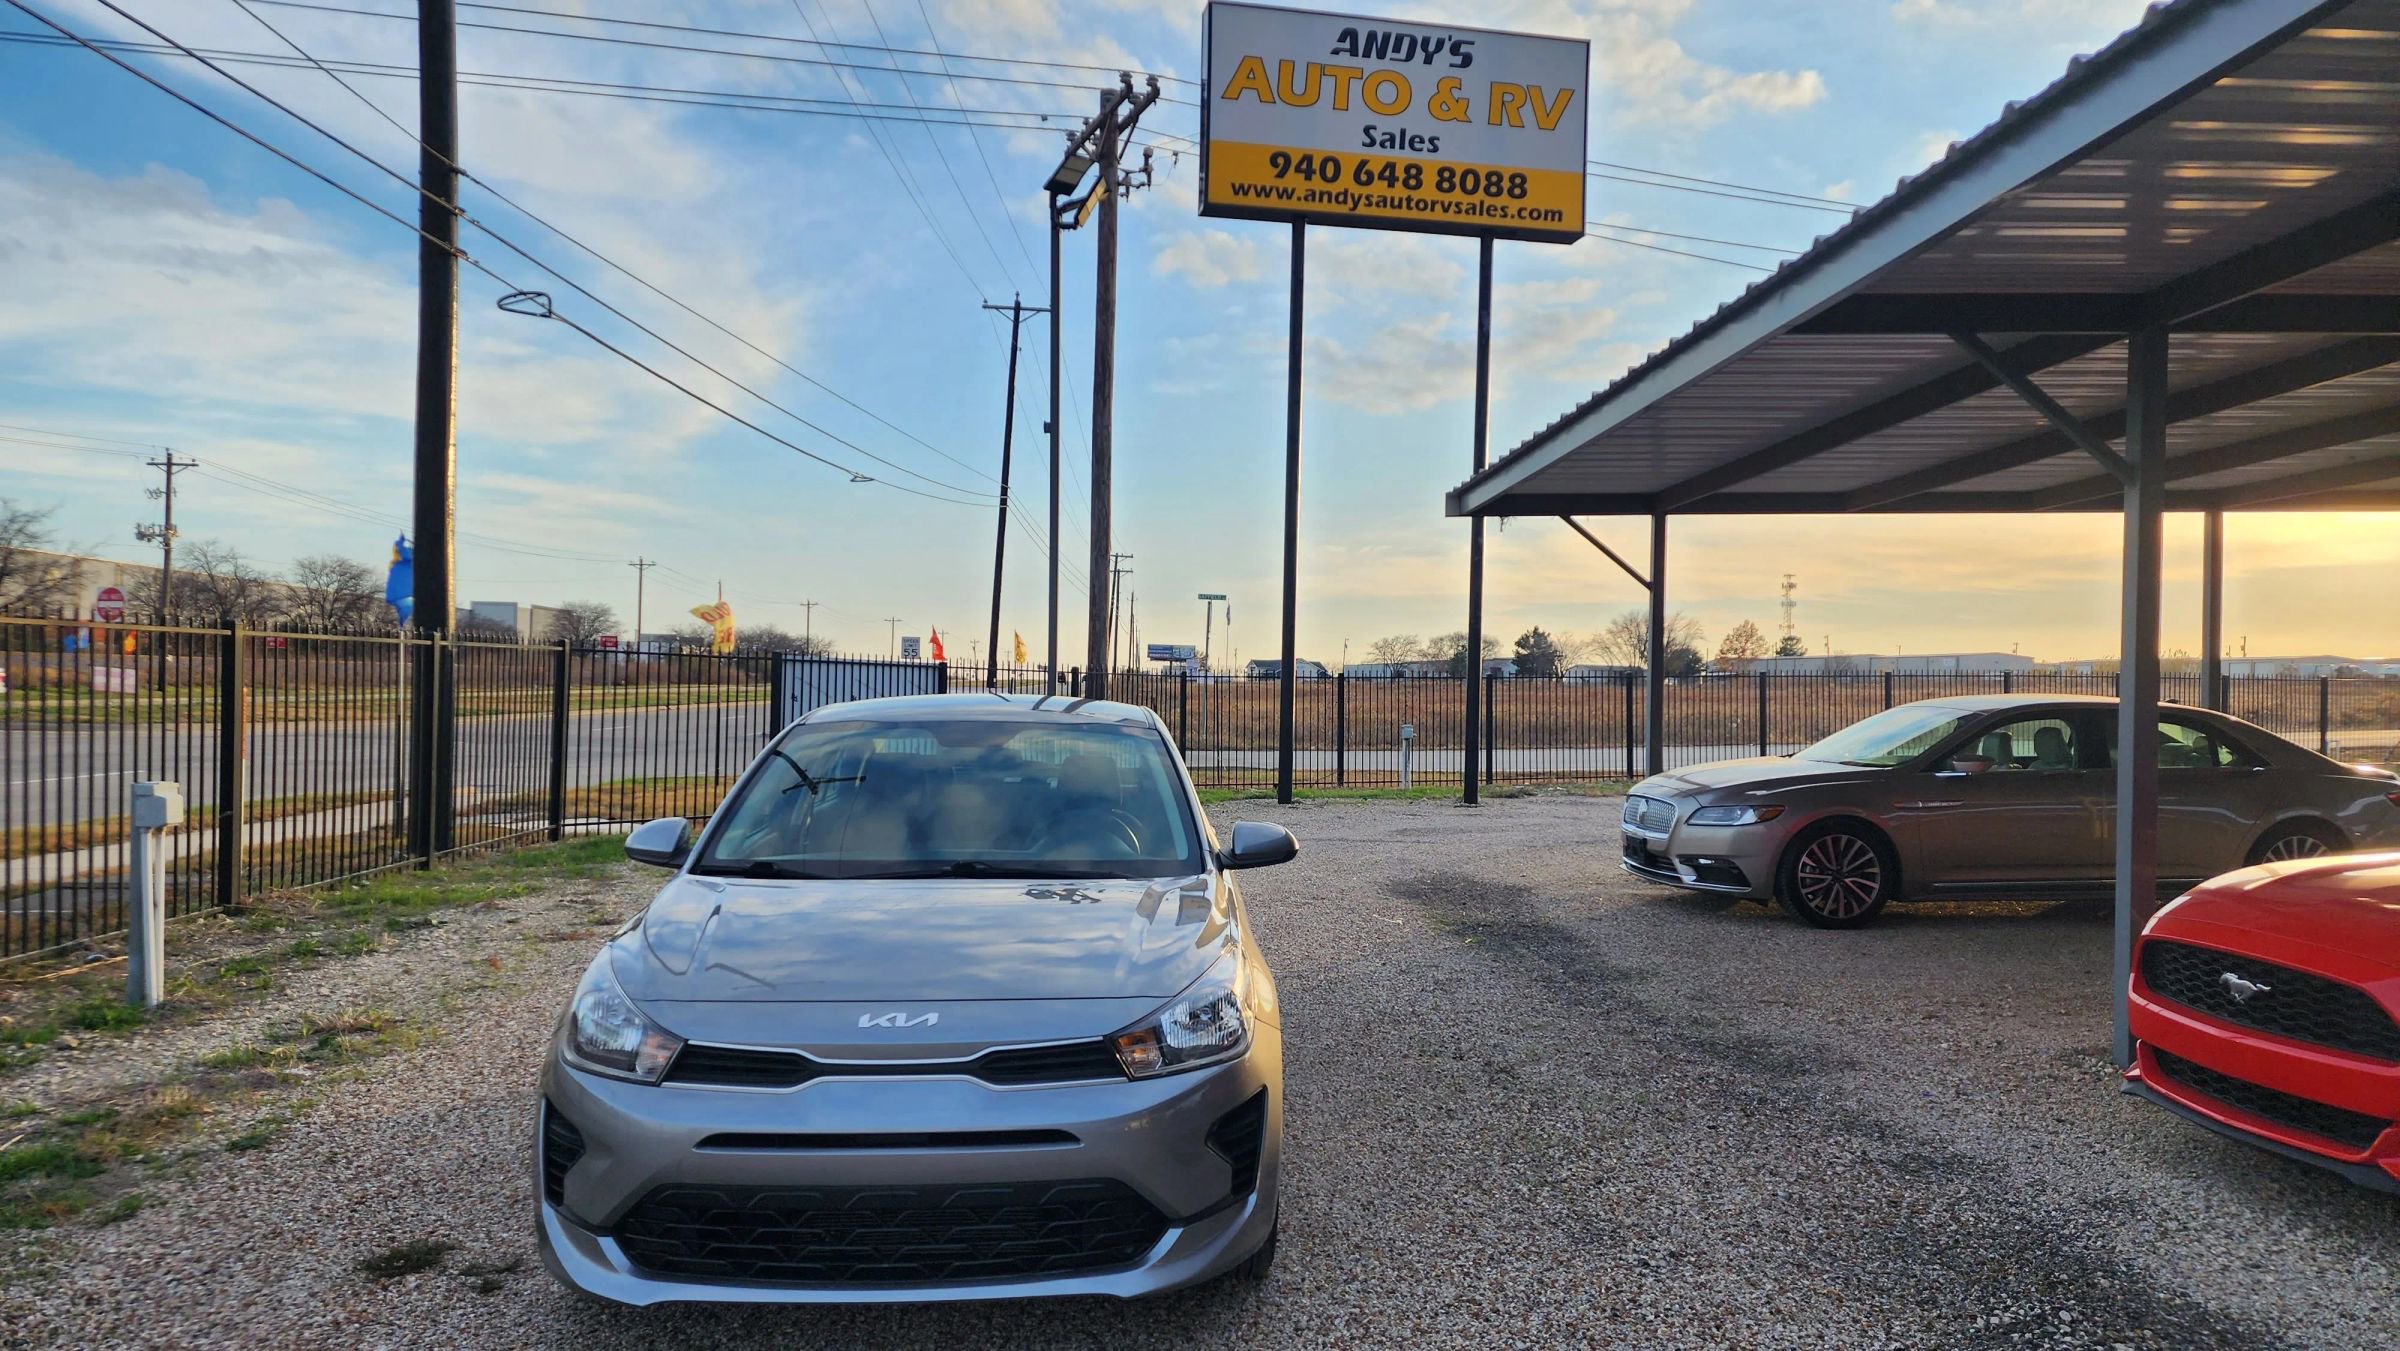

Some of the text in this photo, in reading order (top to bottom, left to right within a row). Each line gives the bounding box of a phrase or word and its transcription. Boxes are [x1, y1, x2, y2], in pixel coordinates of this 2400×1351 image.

[1329, 27, 1476, 69] ANDY'S
[1221, 55, 1575, 131] AUTO & RV
[1361, 124, 1440, 154] Sales
[1269, 151, 1529, 200] 940 648 8088
[1230, 181, 1564, 223] www.andysautorvsales.com
[903, 648, 918, 657] 55
[858, 1012, 939, 1028] KIA
